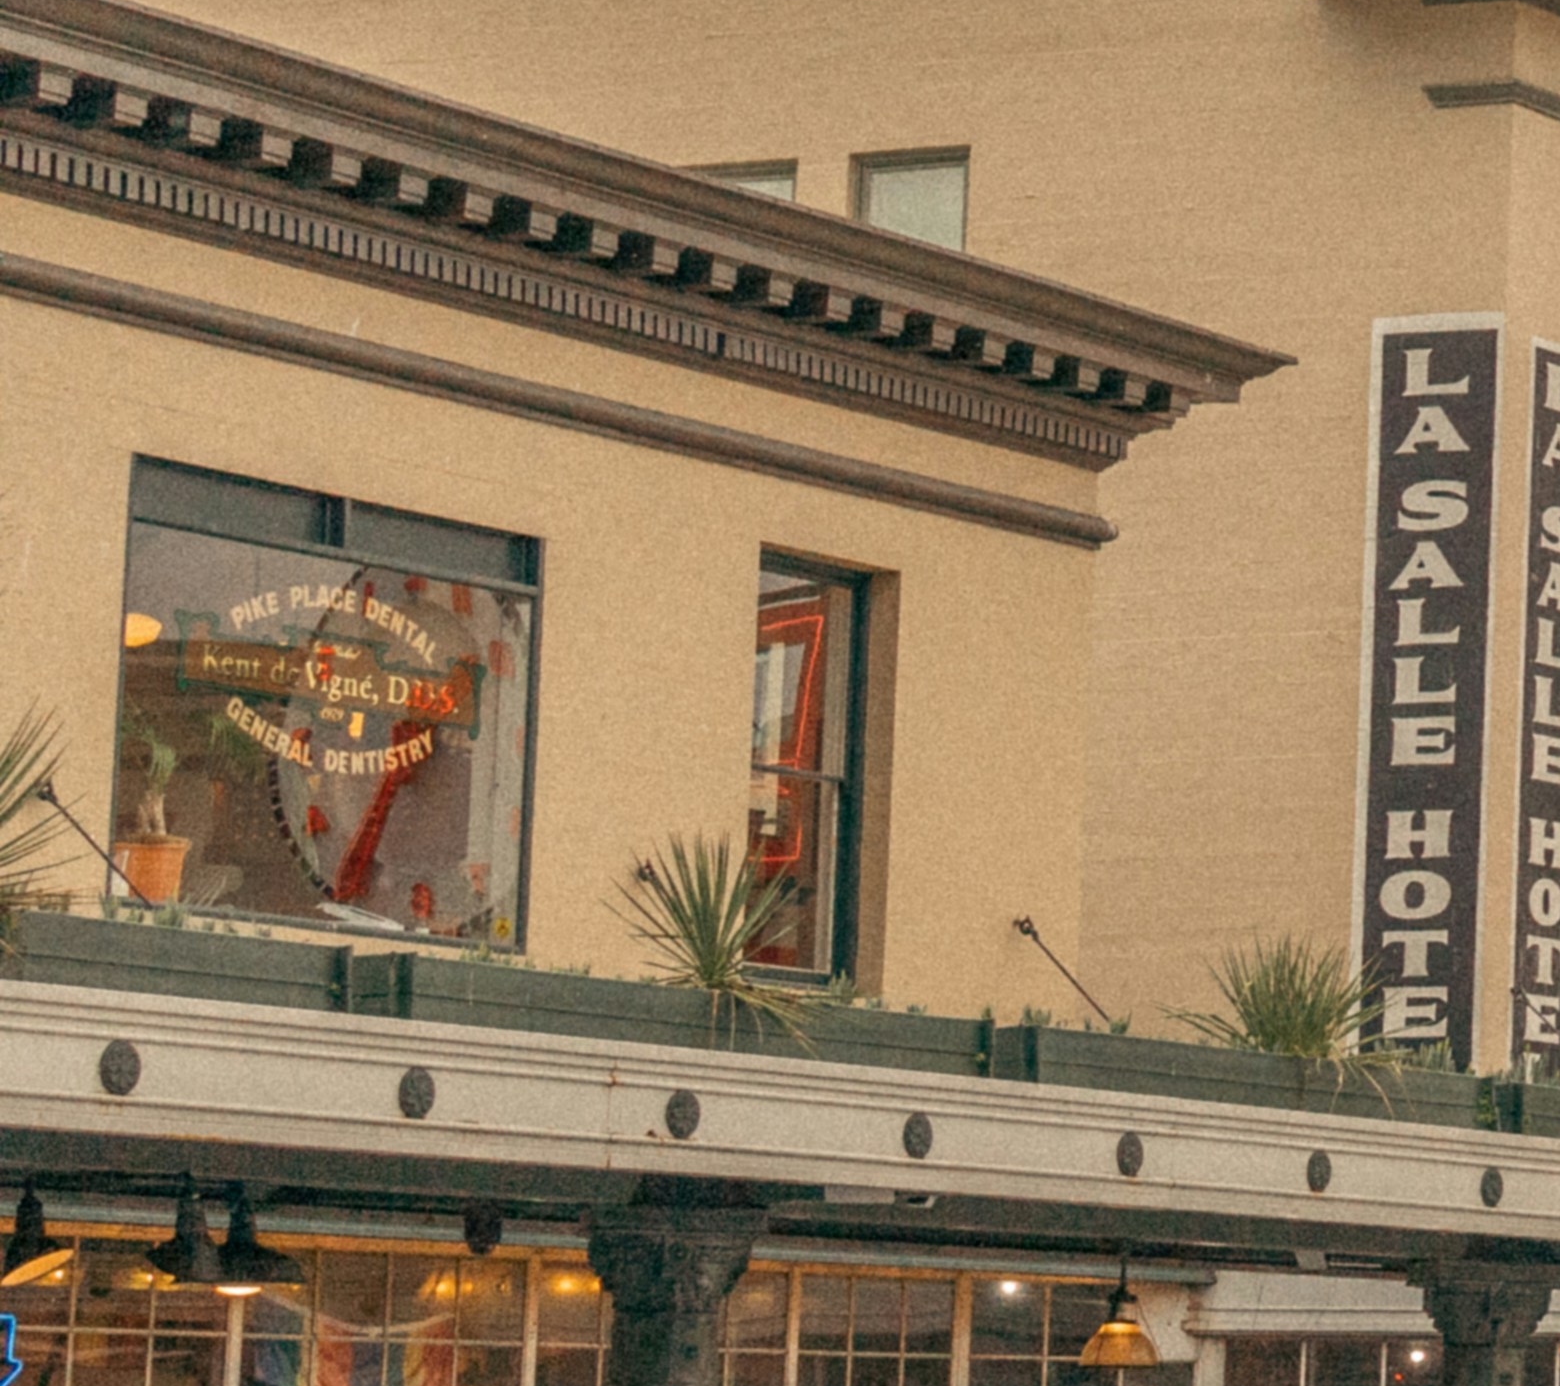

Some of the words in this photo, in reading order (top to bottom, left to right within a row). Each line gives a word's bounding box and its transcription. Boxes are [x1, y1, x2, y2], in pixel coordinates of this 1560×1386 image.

[202, 643, 262, 680] Kent
[229, 591, 280, 631] PIKE
[290, 584, 357, 613] PLACE
[364, 596, 439, 665] DENTAL
[225, 696, 314, 769] GENERAL
[323, 729, 434, 776] DENTISTRY
[1378, 810, 1453, 1039] HOTE
